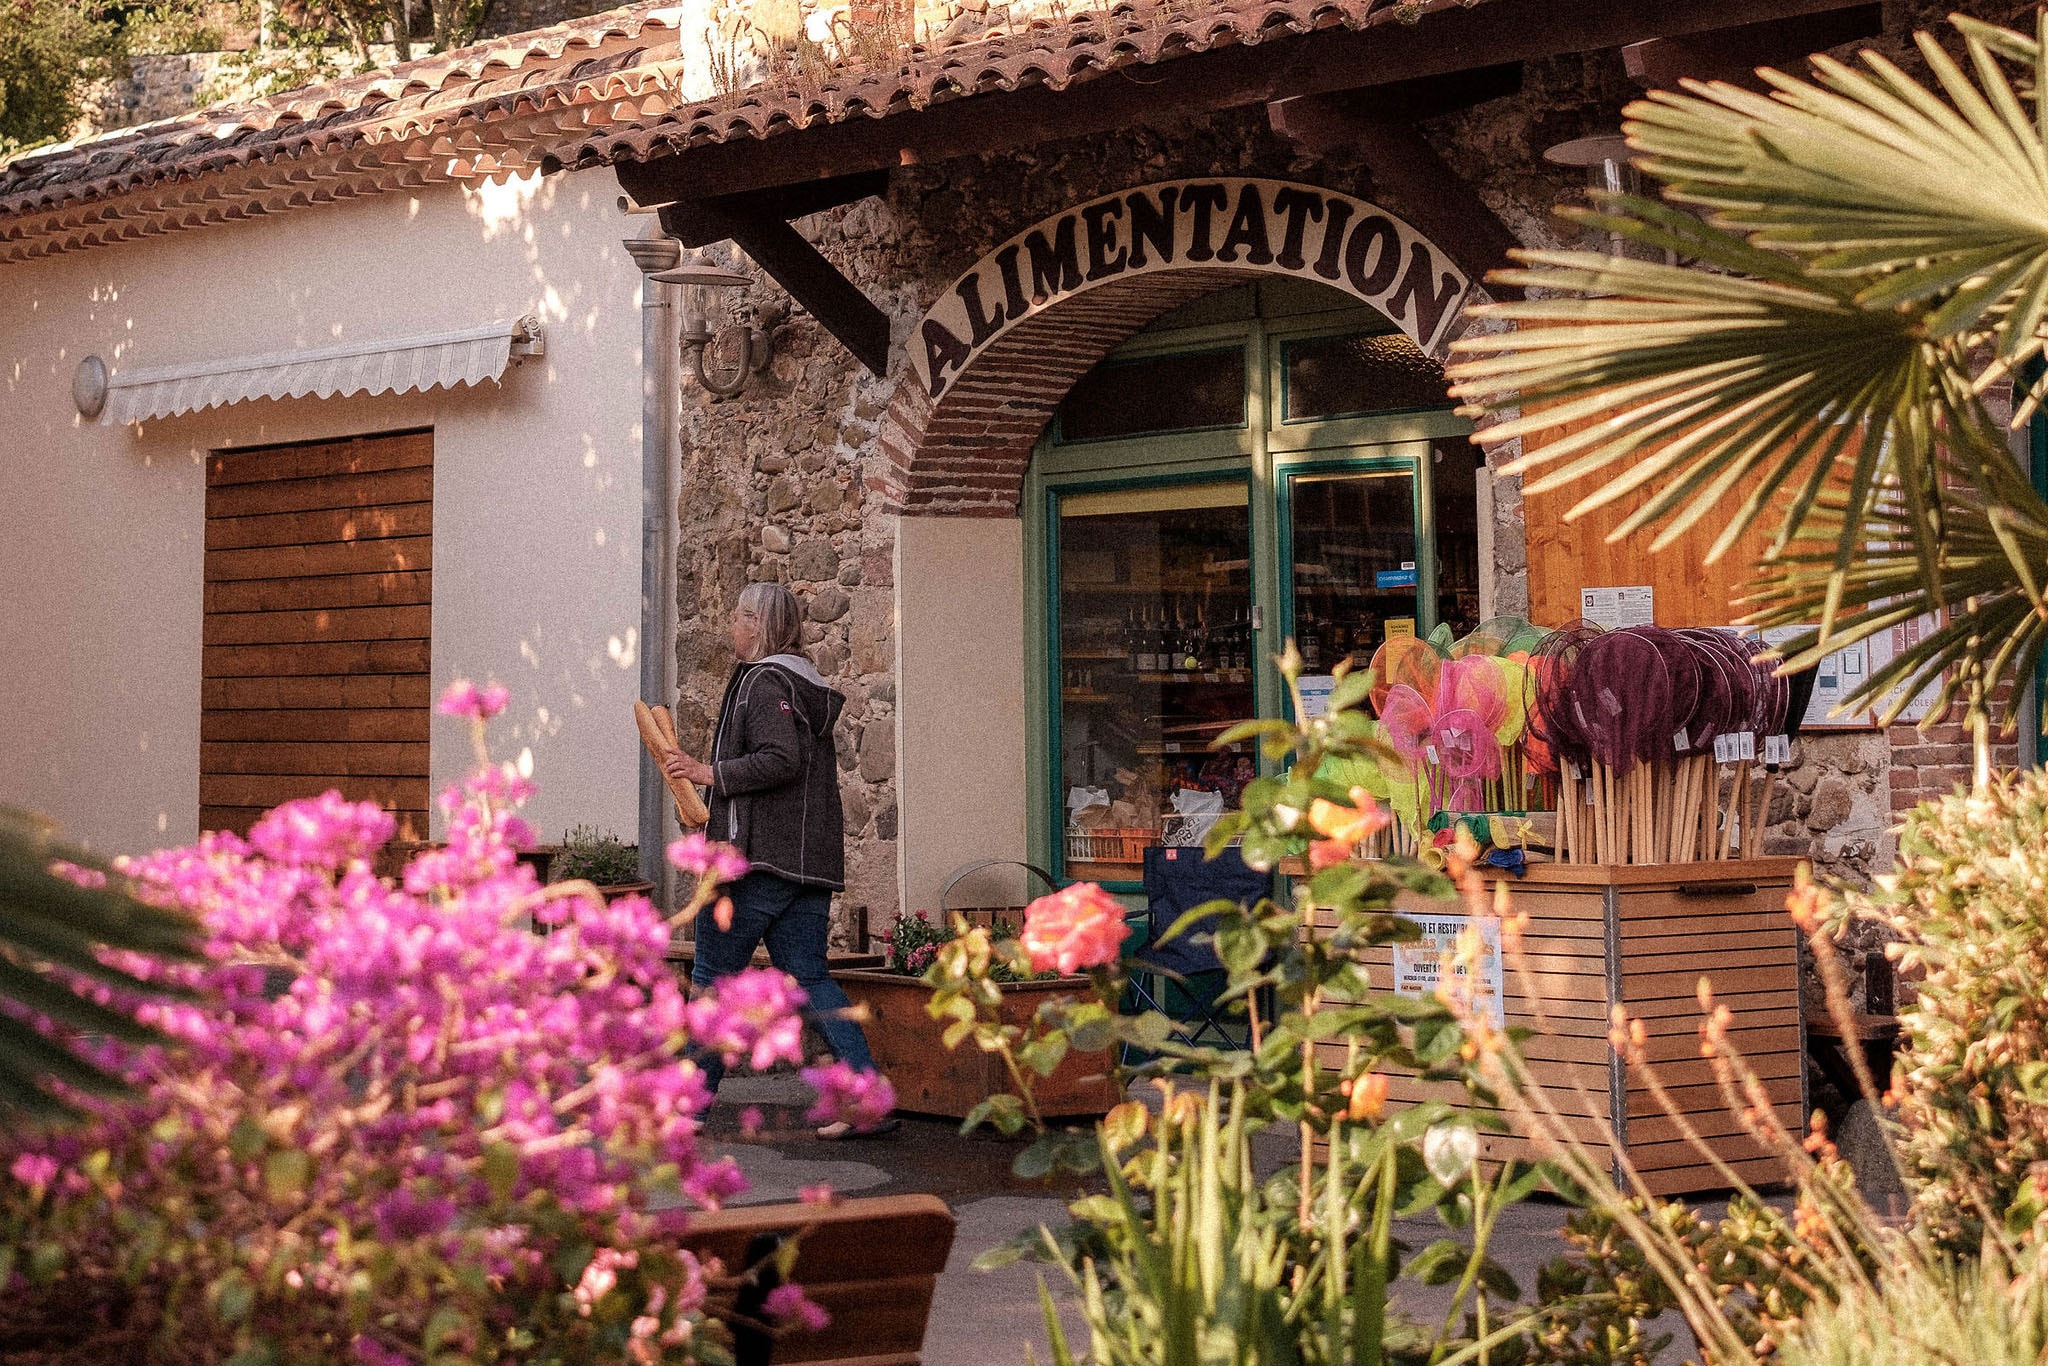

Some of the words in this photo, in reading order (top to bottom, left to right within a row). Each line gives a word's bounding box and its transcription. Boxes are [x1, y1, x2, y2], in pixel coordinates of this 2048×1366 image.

[918, 184, 1461, 397] ALIMENTATION
[1428, 922, 1436, 934] ET
[1413, 963, 1432, 973] OUVERT
